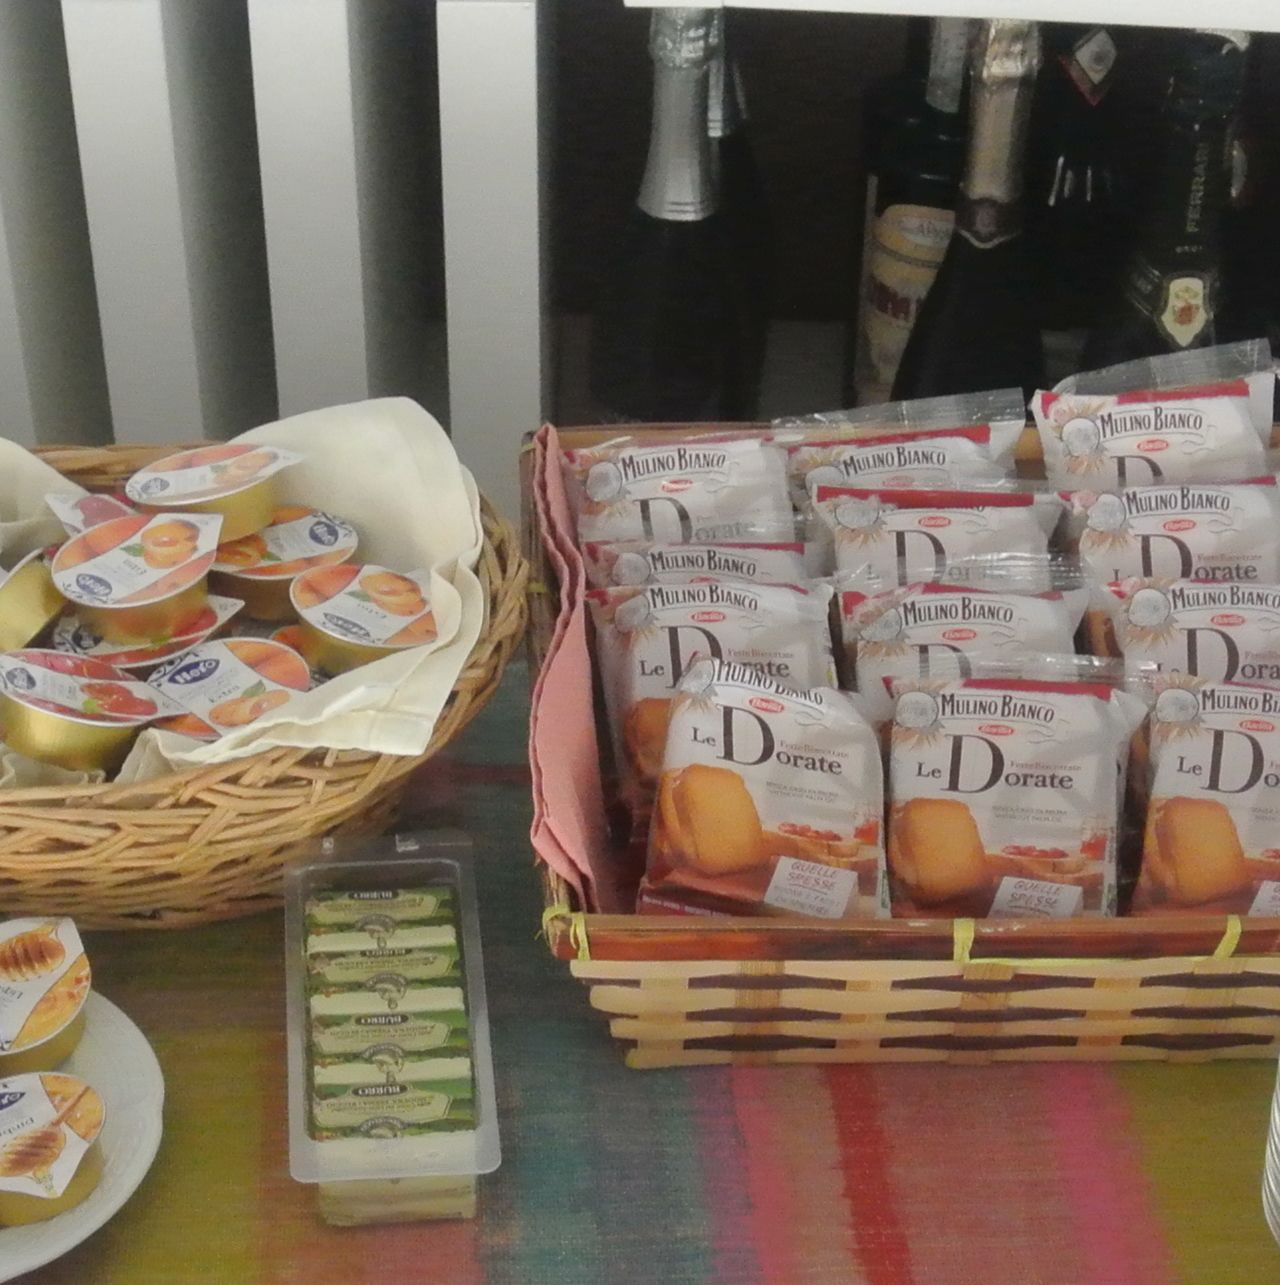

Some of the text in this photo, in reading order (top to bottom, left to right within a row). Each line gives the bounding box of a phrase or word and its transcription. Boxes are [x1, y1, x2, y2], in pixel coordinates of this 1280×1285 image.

[1100, 406, 1203, 438] MULINO BIANCO
[622, 447, 726, 481] MULINO BIANCO
[843, 446, 946, 477] MULINO BIANCO
[1125, 487, 1230, 514] MULINO BIANCO
[650, 550, 756, 577] MULINO BIANCO
[650, 585, 758, 611] MULINO BIANCO
[903, 597, 1013, 626] MULINO BIANCO
[1172, 588, 1227, 610] MULINO
[174, 659, 218, 685] Hero
[640, 660, 664, 677] Le
[940, 693, 1055, 724] MULINO BIANCO
[1201, 688, 1259, 712] MULINO
[690, 703, 843, 775] Le Dorate
[916, 734, 1074, 794] Le Dorate
[1176, 756, 1202, 775] Le
[361, 1015, 403, 1026] BURRO
[358, 1085, 401, 1096] BURRO
